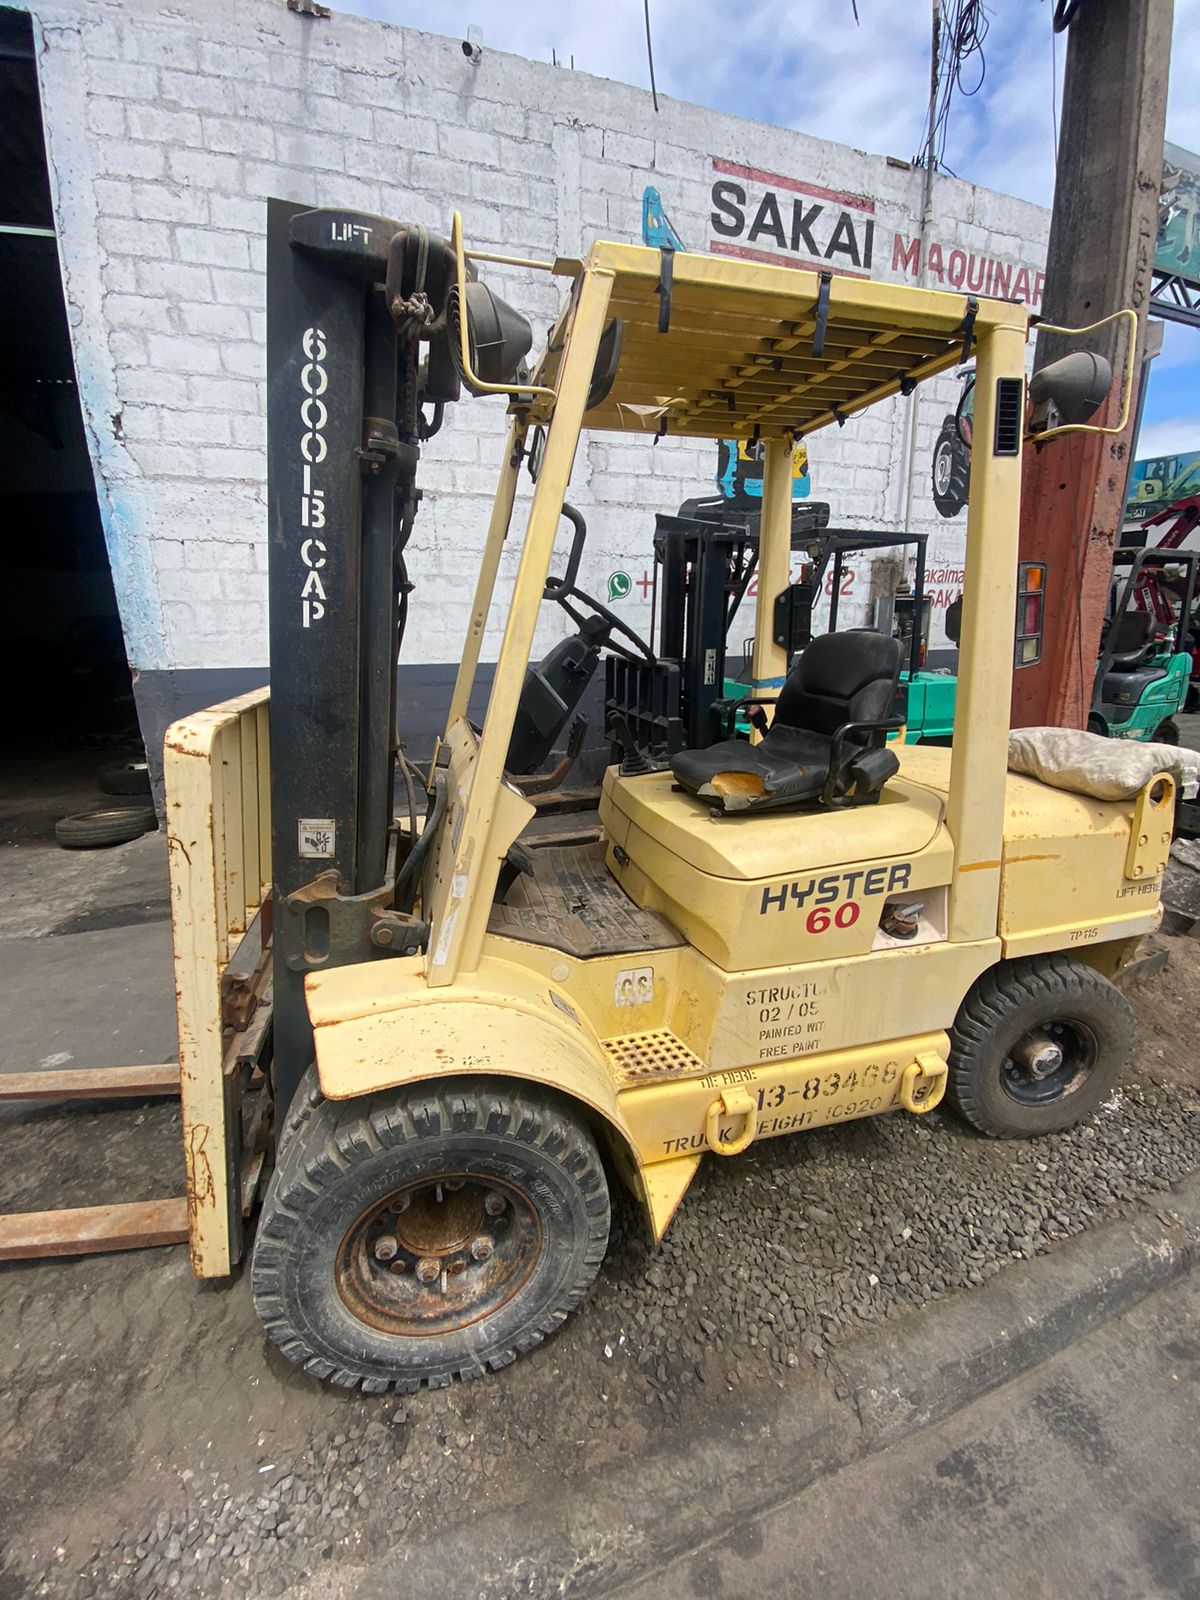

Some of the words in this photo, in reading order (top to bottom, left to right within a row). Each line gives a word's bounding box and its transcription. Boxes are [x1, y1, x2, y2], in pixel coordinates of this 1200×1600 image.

[331, 222, 373, 245] LIFT
[710, 179, 875, 270] SAKAI
[760, 862, 912, 915] HYSTER
[1115, 886, 1137, 899] LIFT
[1137, 882, 1161, 895] HERE
[805, 901, 860, 935] 60
[759, 1024, 802, 1041] PAINTED
[759, 1045, 788, 1059] FREE
[792, 1039, 821, 1053] PAINT
[697, 1075, 719, 1089] TIE
[721, 1069, 758, 1085] HERE
[663, 1127, 733, 1154] TRUK
[744, 1109, 818, 1134] EIGHT
